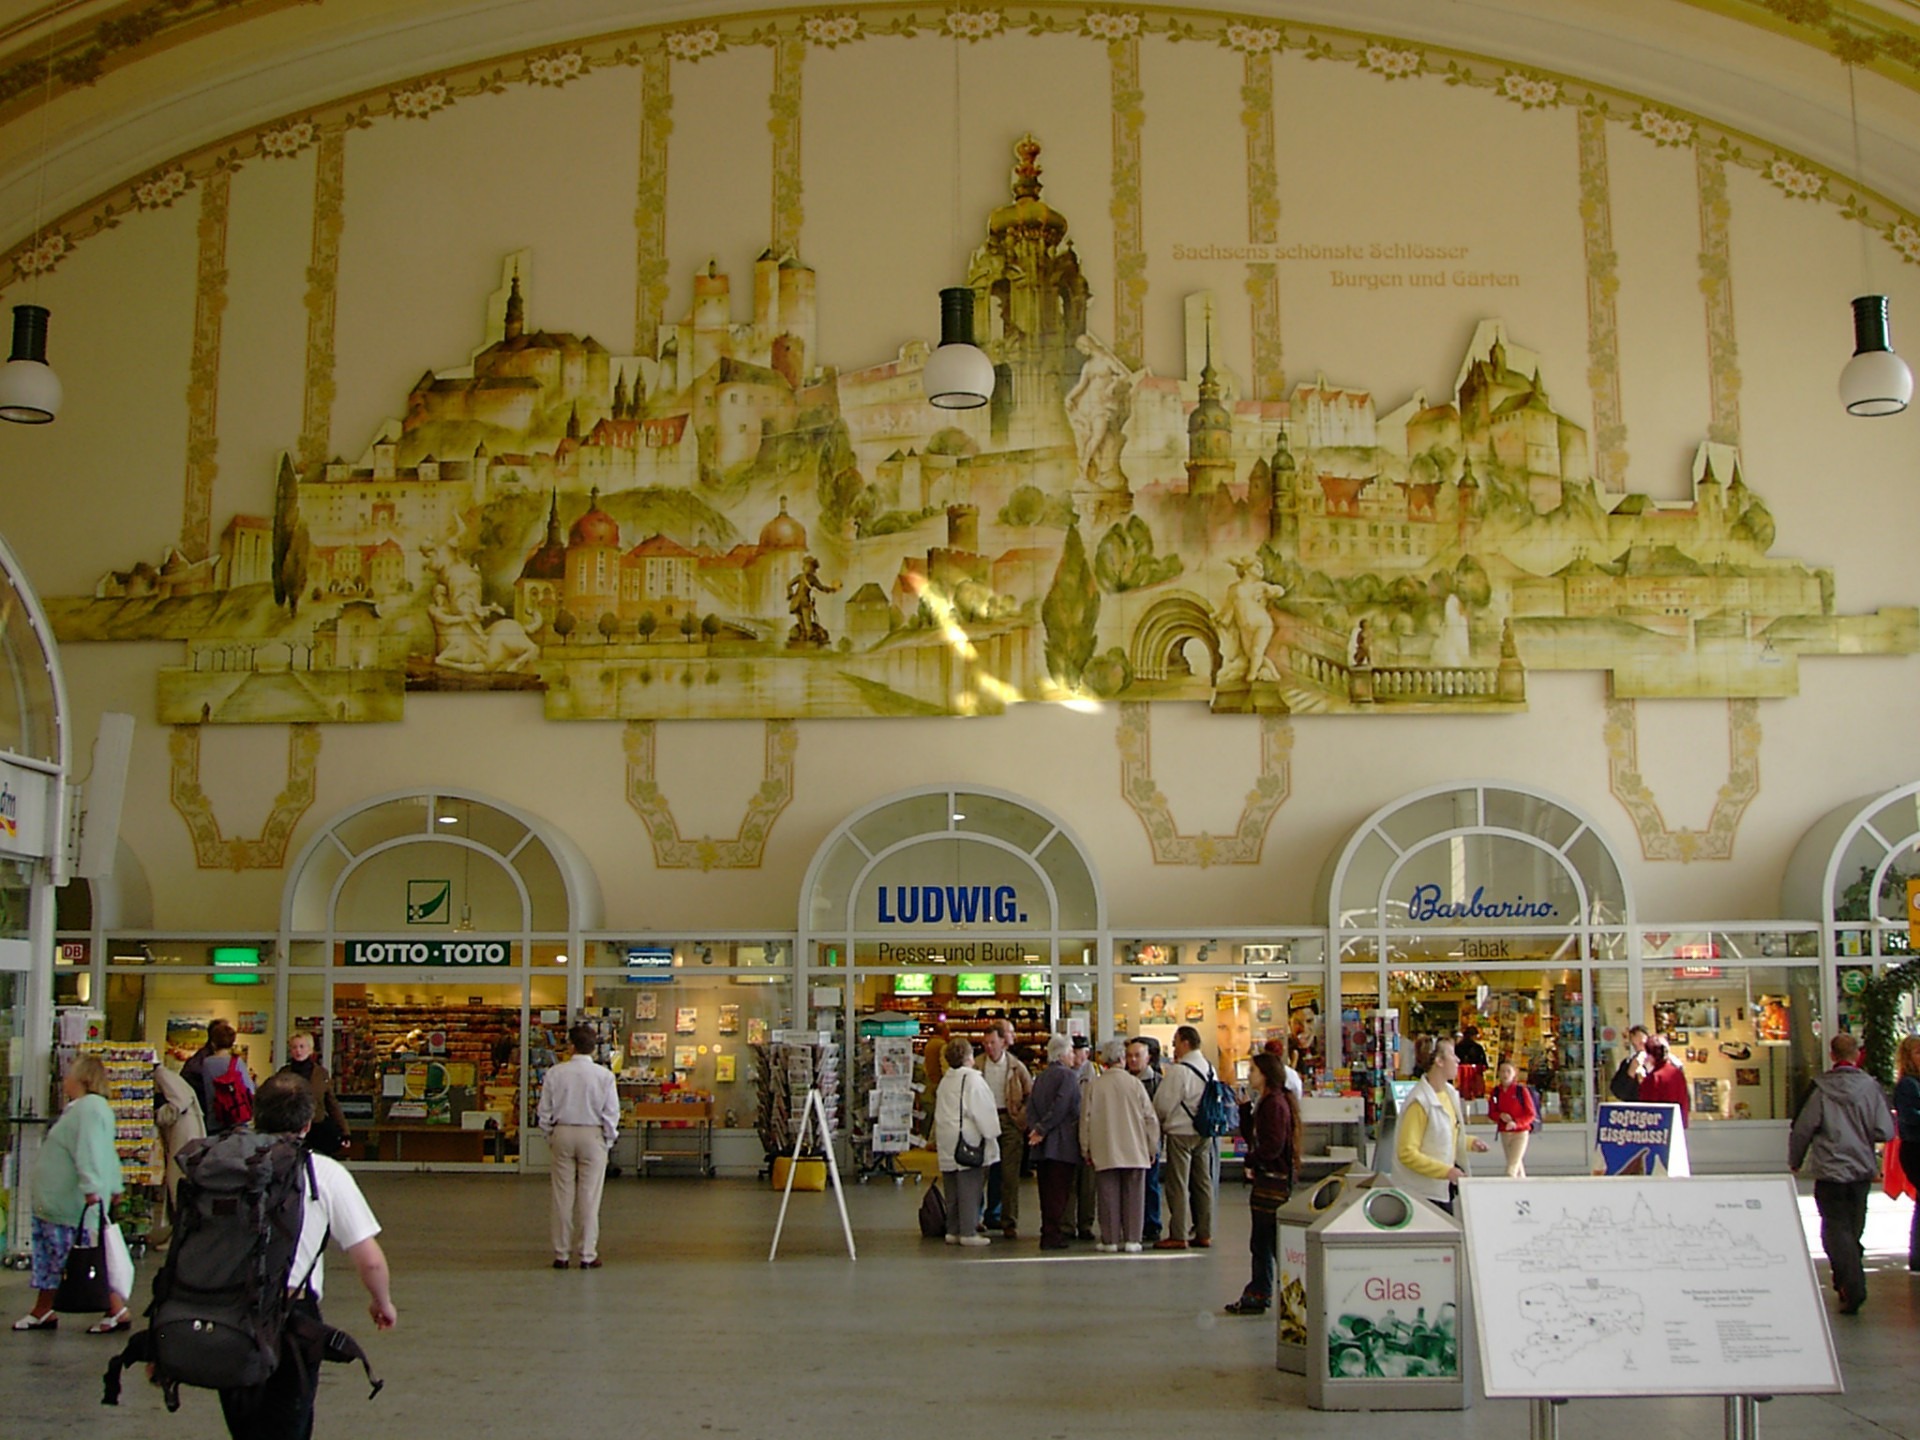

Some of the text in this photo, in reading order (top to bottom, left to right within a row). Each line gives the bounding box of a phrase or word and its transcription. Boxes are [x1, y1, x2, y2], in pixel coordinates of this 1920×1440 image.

[1172, 242, 1470, 260] Sachsens schönste Schlösser
[1330, 268, 1521, 289] Burgen und Gärten
[878, 886, 1028, 923] LUDWIG.
[1408, 883, 1559, 922] Barbarino.
[63, 944, 83, 959] DB
[355, 943, 505, 963] LOTTO TOTO
[878, 942, 1026, 962] Presse und Buch
[1459, 938, 1510, 958] Tabak
[1609, 1110, 1662, 1129] Softiger
[1599, 1126, 1669, 1146] Eisgenuss!
[1364, 1277, 1422, 1301] Glas
